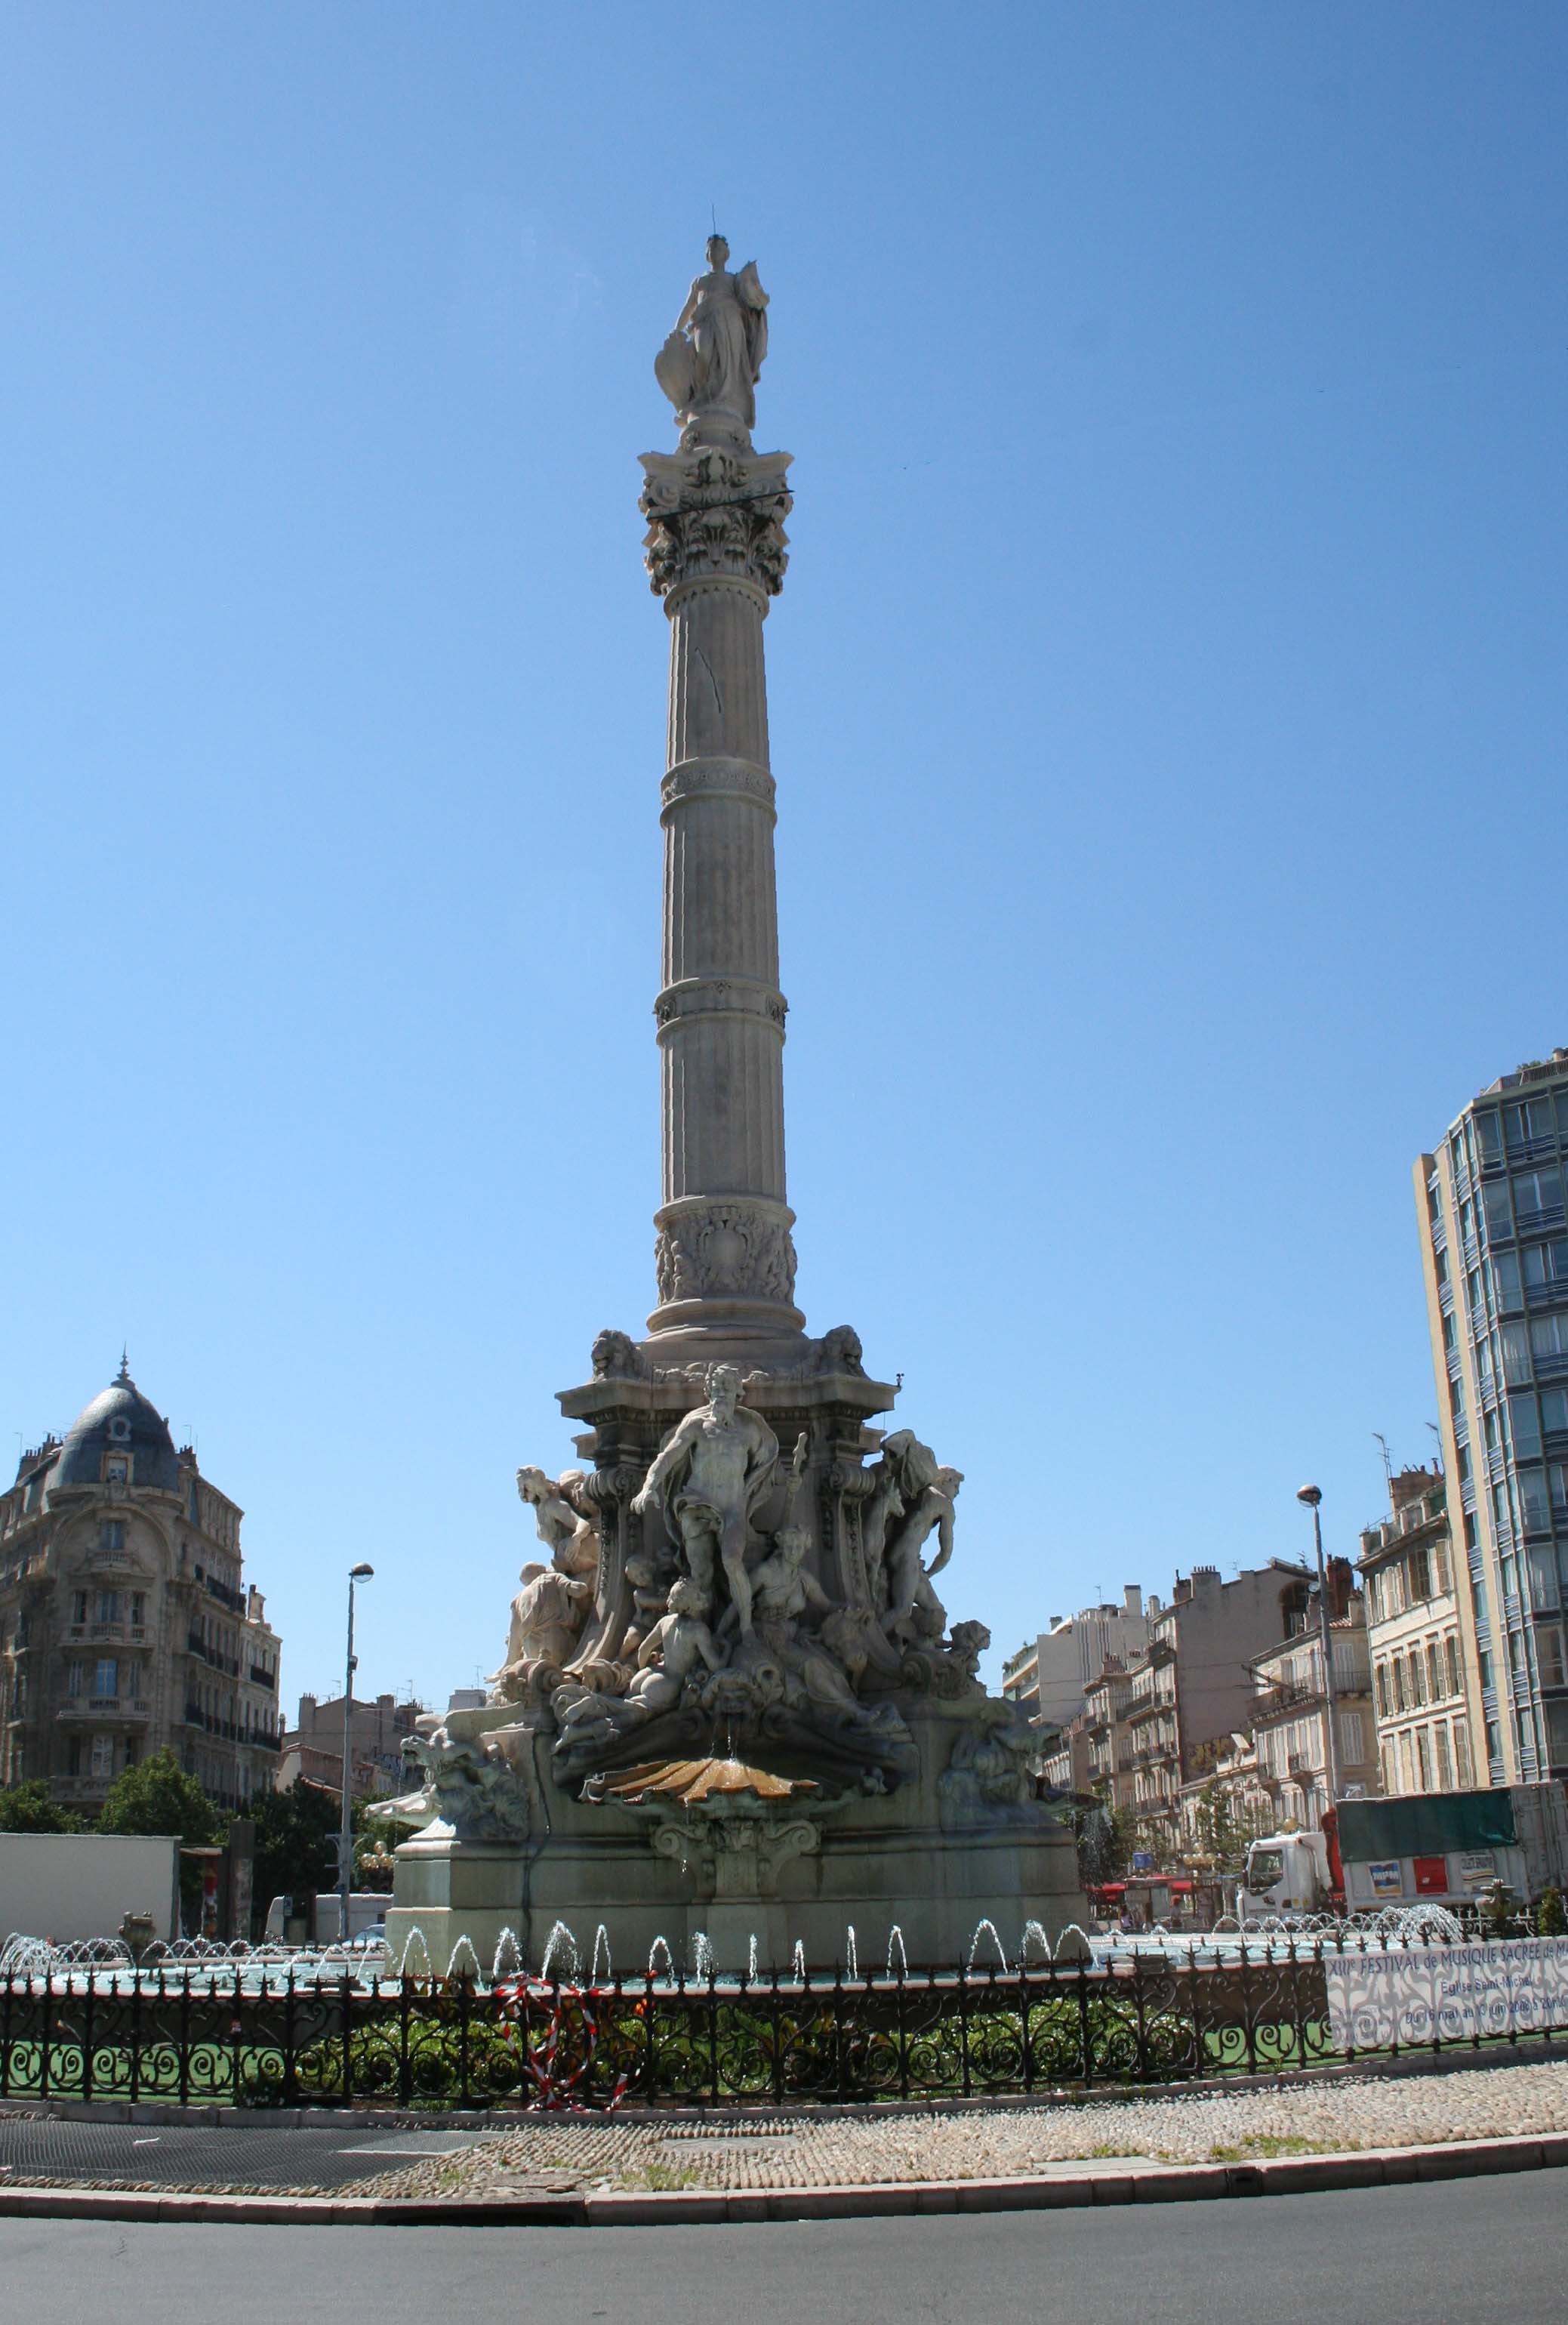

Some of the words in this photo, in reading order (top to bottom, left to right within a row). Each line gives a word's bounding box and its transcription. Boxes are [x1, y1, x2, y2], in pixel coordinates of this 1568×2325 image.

[1360, 1953, 1420, 1975] FESTIVAL
[1424, 1954, 1437, 1969] de
[1440, 1946, 1497, 1967] MUSIQUE
[1543, 1944, 1554, 1958] de
[1474, 1975, 1533, 1990] Saint-Michel
[1406, 2010, 1419, 2024] Du
[1438, 2006, 1459, 2020] mai
[1462, 2007, 1474, 2018] au
